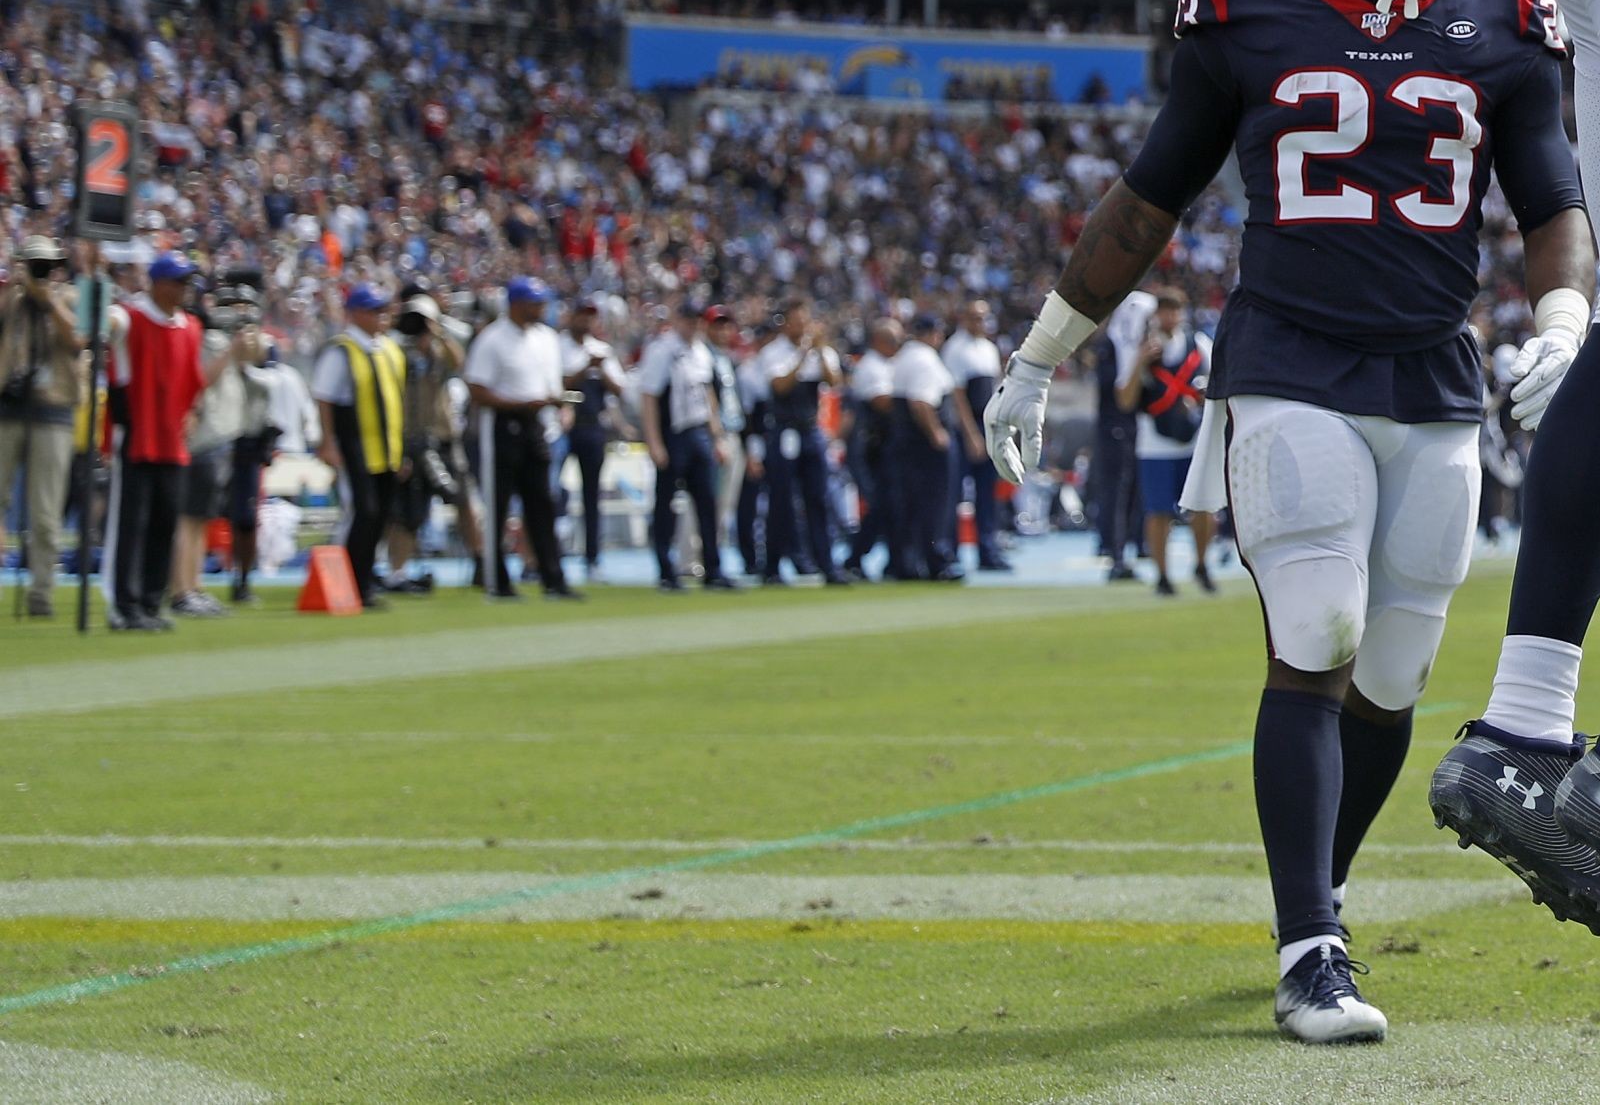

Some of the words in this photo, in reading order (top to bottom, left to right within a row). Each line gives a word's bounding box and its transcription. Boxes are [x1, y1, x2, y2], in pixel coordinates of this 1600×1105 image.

[1344, 51, 1414, 62] TEXANS
[84, 119, 131, 193] 2
[1270, 65, 1484, 234] 23
